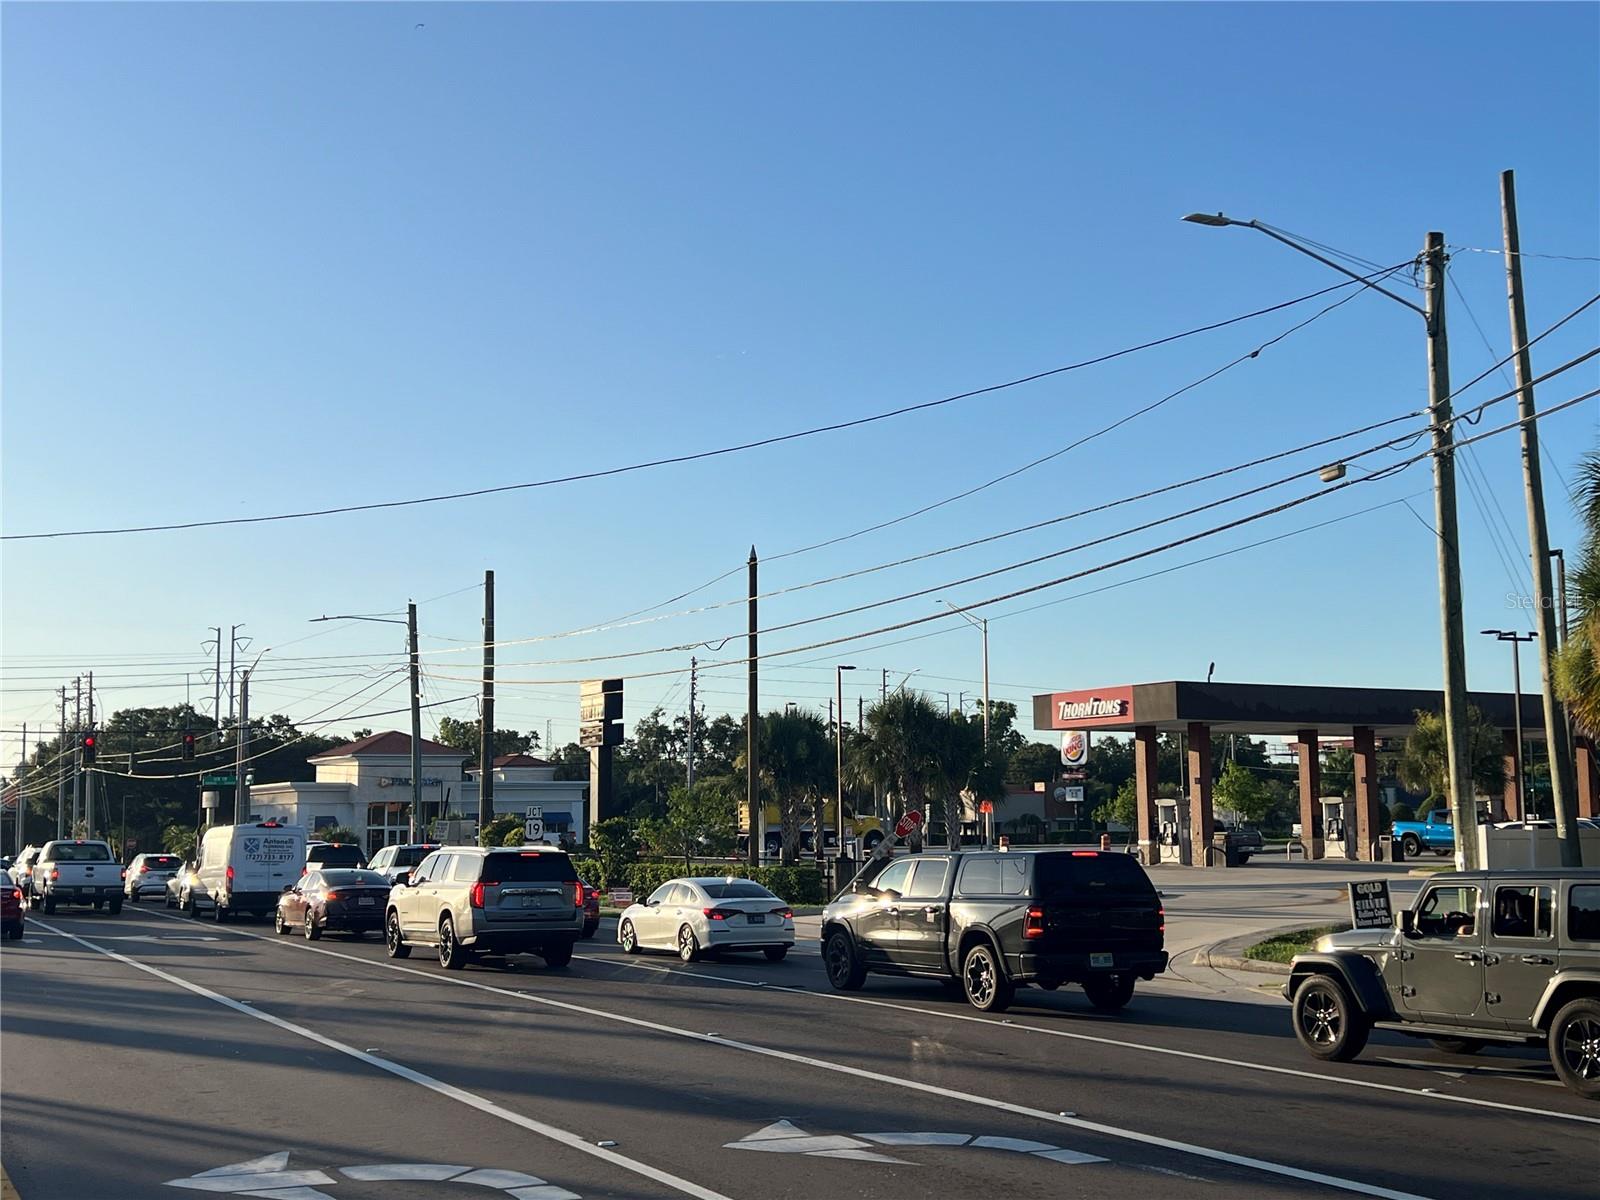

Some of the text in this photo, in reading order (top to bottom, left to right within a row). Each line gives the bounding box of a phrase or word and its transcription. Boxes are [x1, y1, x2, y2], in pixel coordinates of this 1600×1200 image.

[1065, 741, 1083, 755] KING
[527, 807, 542, 817] JCT
[528, 823, 540, 836] 19
[900, 816, 915, 831] STOP
[1356, 883, 1382, 894] GOLD
